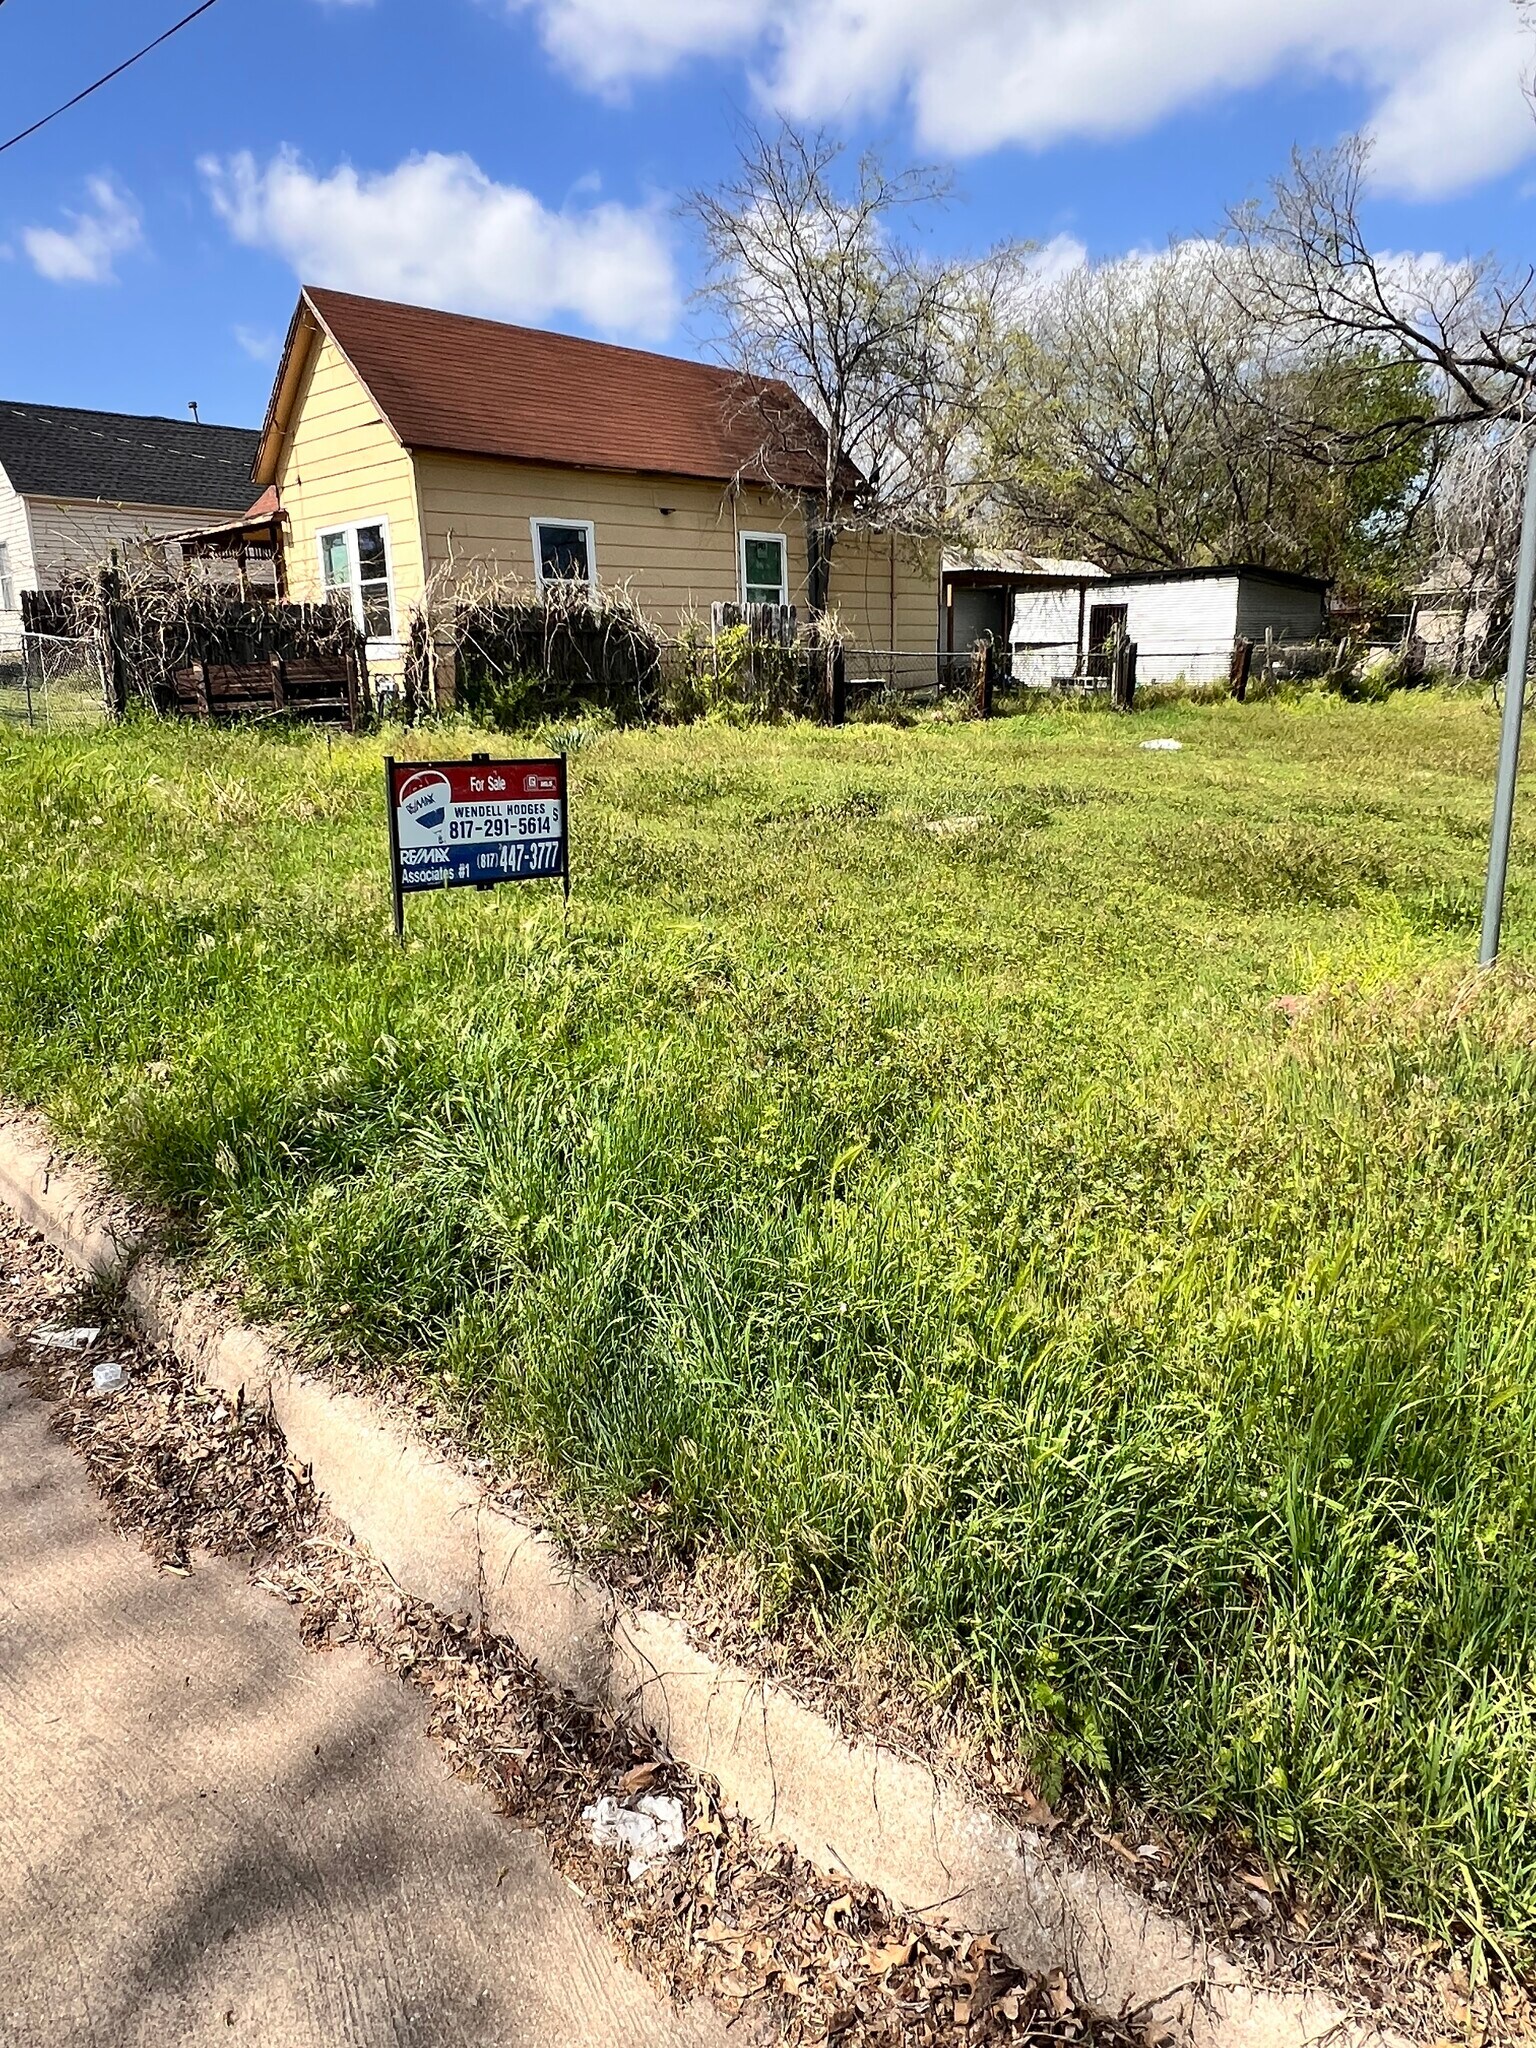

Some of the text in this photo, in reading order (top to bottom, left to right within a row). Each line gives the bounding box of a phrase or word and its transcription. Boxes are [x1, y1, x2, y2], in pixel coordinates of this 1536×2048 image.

[470, 775, 506, 792] For Sale
[454, 803, 546, 818] WENDELL HODGES
[449, 817, 551, 840] 817-291-5614
[400, 847, 451, 866] RE/MAX
[476, 841, 559, 873] (817) 447-3777
[401, 863, 470, 884] Associates #1
